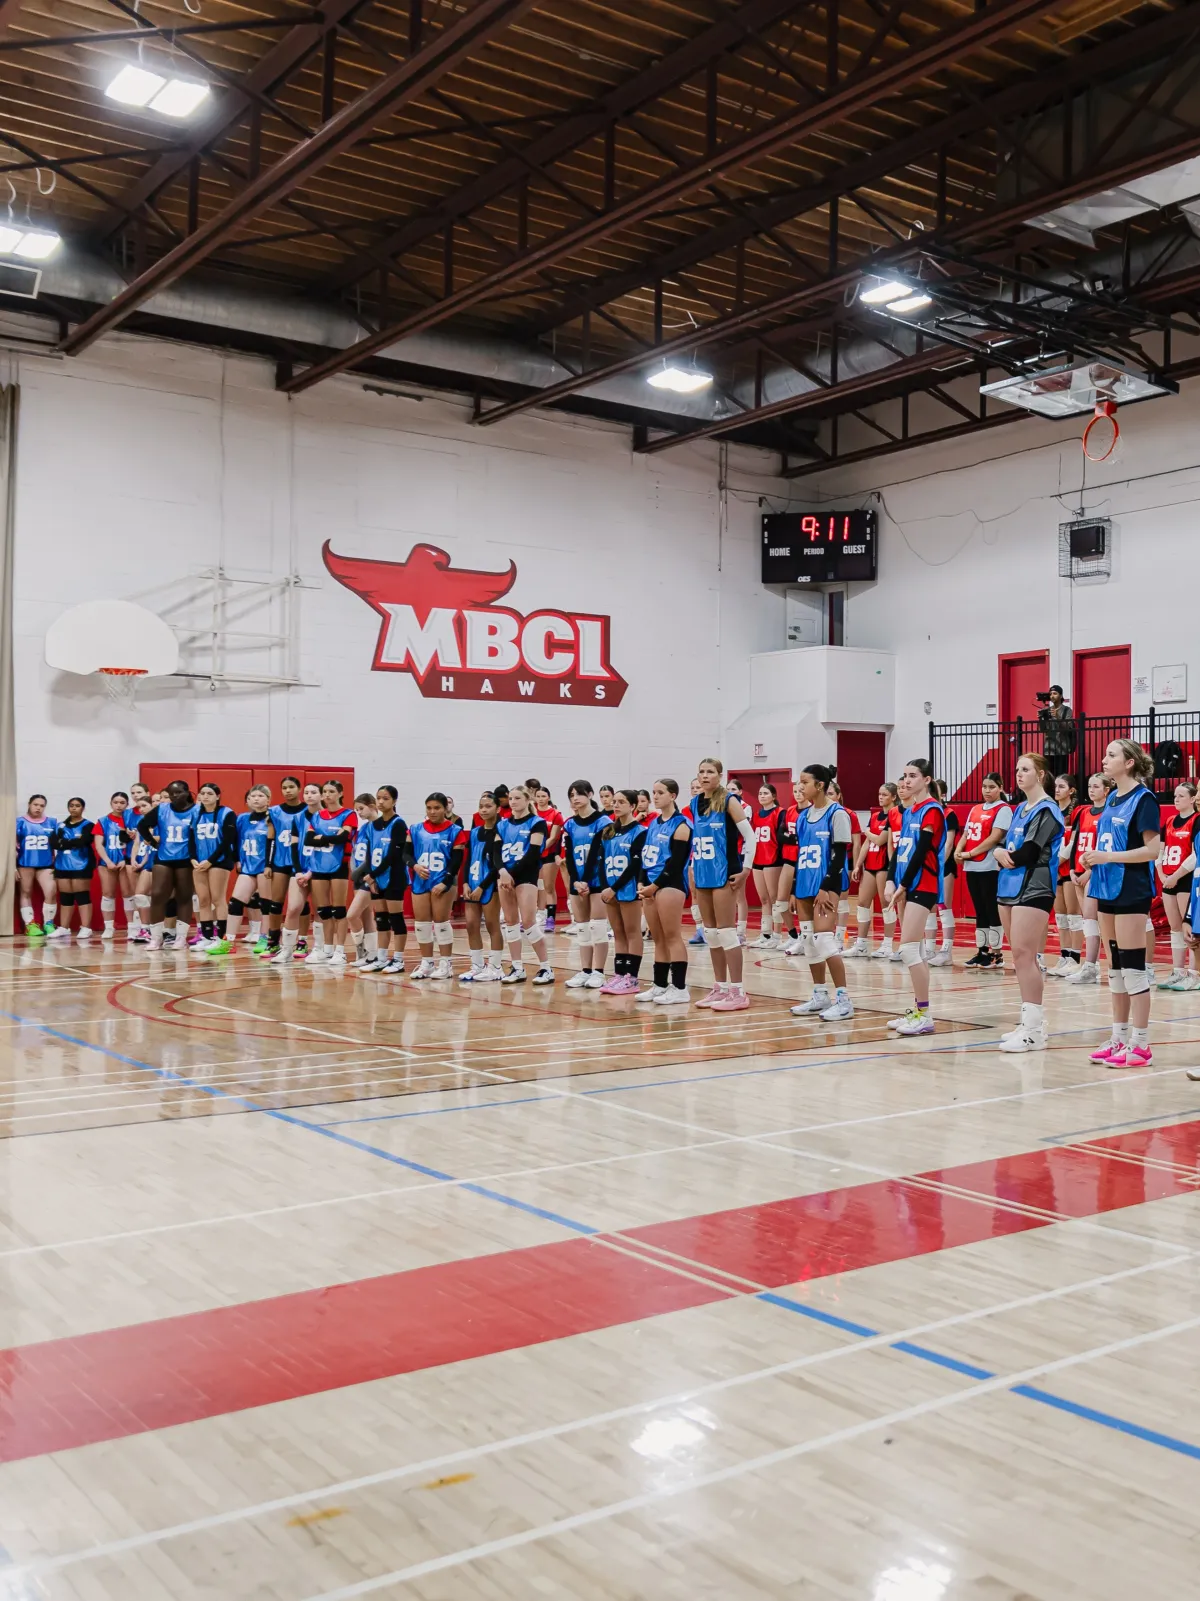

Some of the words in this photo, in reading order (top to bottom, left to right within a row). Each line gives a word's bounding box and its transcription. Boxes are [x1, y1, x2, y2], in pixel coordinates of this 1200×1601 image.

[801, 517, 849, 541] 9:11
[769, 547, 791, 556] HOME
[842, 545, 866, 554] GUEST
[378, 602, 611, 677] MBCI
[441, 677, 606, 699] HAWKS
[166, 826, 185, 842] 11
[197, 823, 218, 840] 50
[1077, 832, 1094, 852] 51
[25, 835, 48, 850] 22
[242, 839, 259, 856] 41
[501, 842, 525, 863] 24
[692, 836, 716, 860] 35
[417, 852, 445, 872] 46
[798, 844, 822, 870] 23
[1162, 845, 1181, 866] 48
[605, 855, 628, 878] 29
